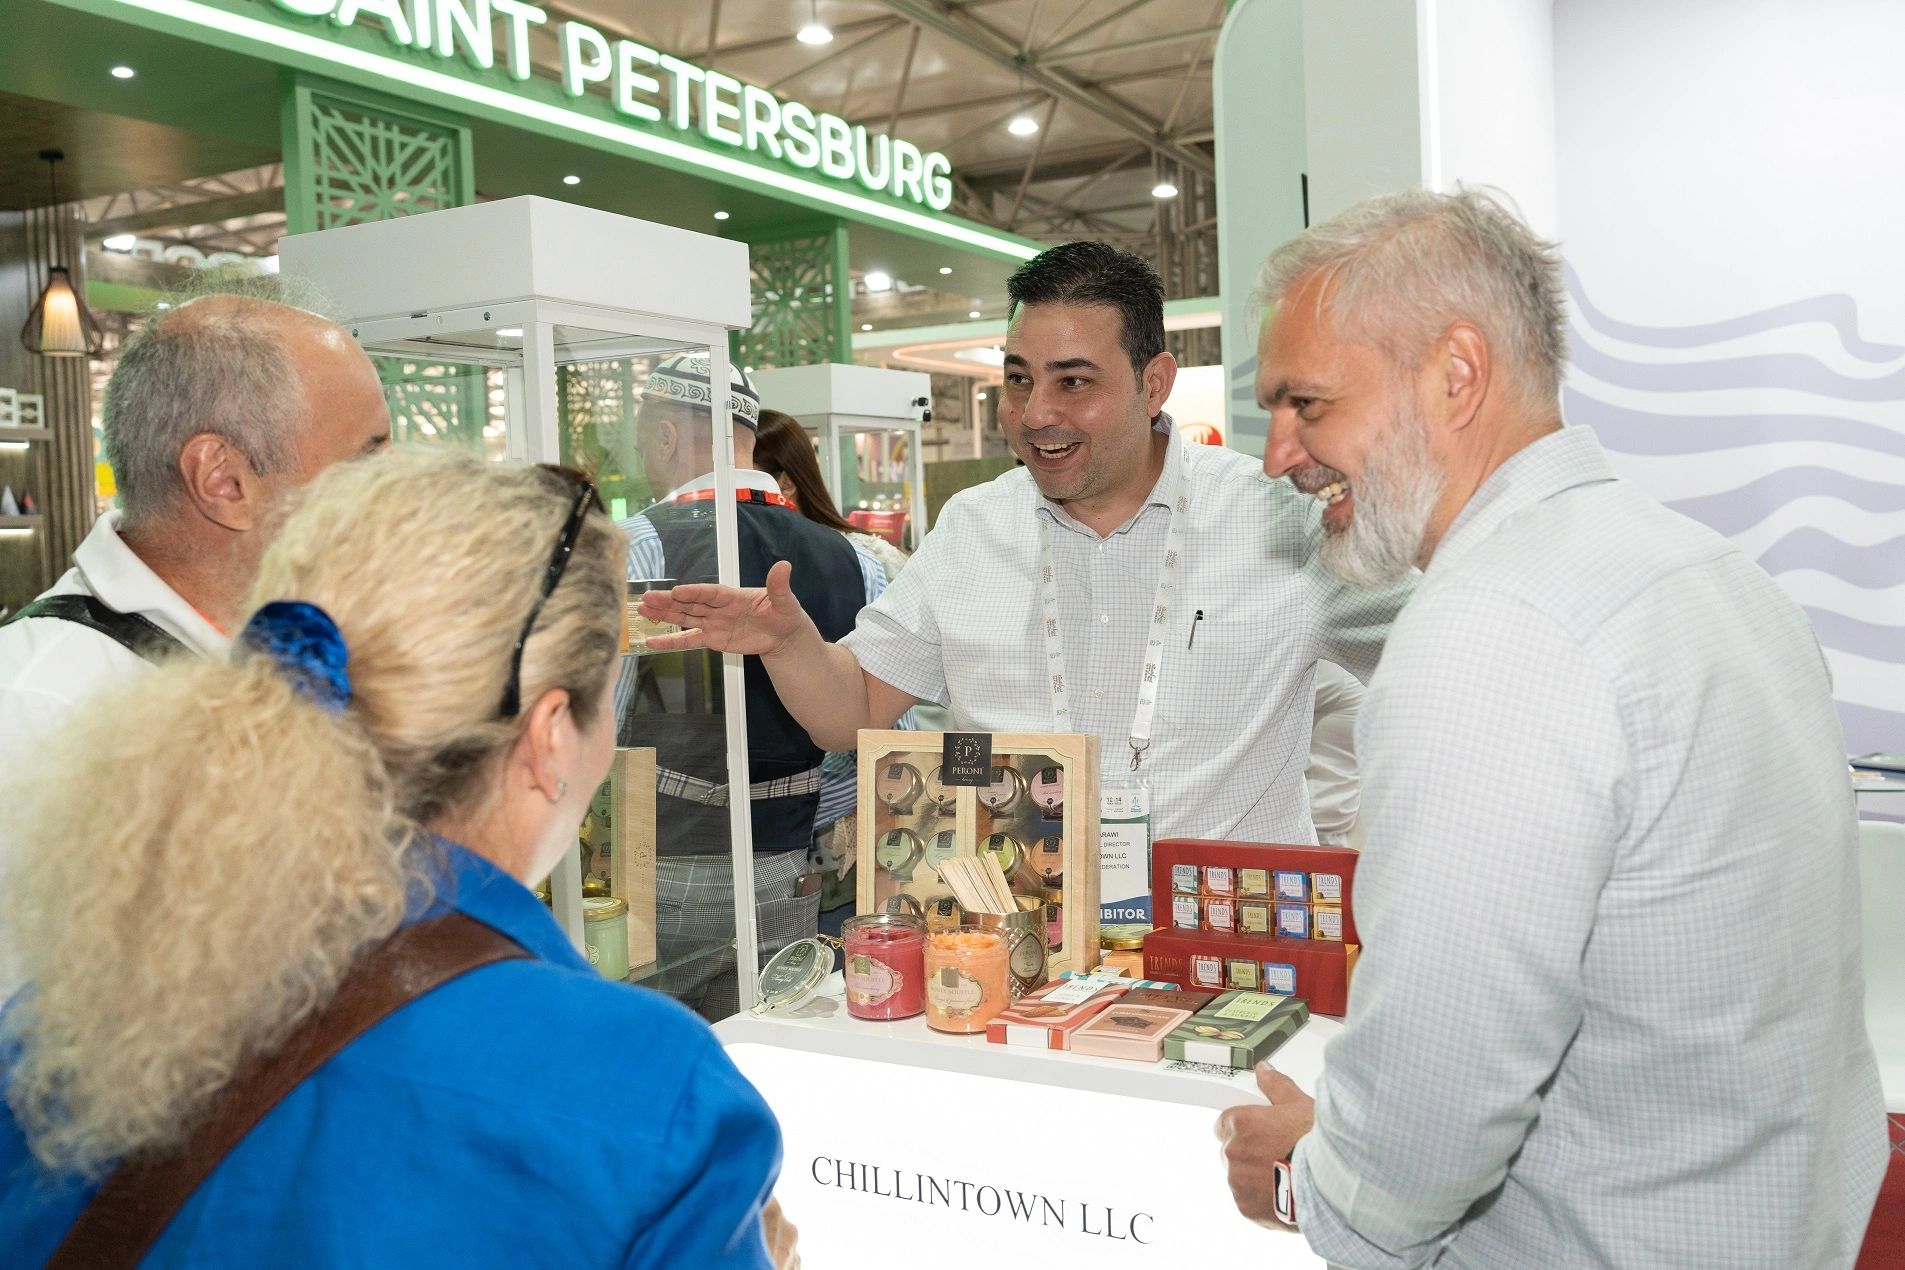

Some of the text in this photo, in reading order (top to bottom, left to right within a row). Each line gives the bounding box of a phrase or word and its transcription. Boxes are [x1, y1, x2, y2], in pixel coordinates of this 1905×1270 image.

[270, 0, 953, 211] AINT PETERSBURG
[952, 766, 983, 775] PERONI
[1210, 870, 1227, 879] TRENDS
[1318, 876, 1338, 885] TRENDS
[1210, 906, 1228, 916] TRENDS
[1149, 955, 1183, 971] TRENDS
[1198, 962, 1217, 972] TRENDS
[1235, 997, 1276, 1007] TRENDS
[811, 1156, 1154, 1245] CHILLINTOWN LLC
